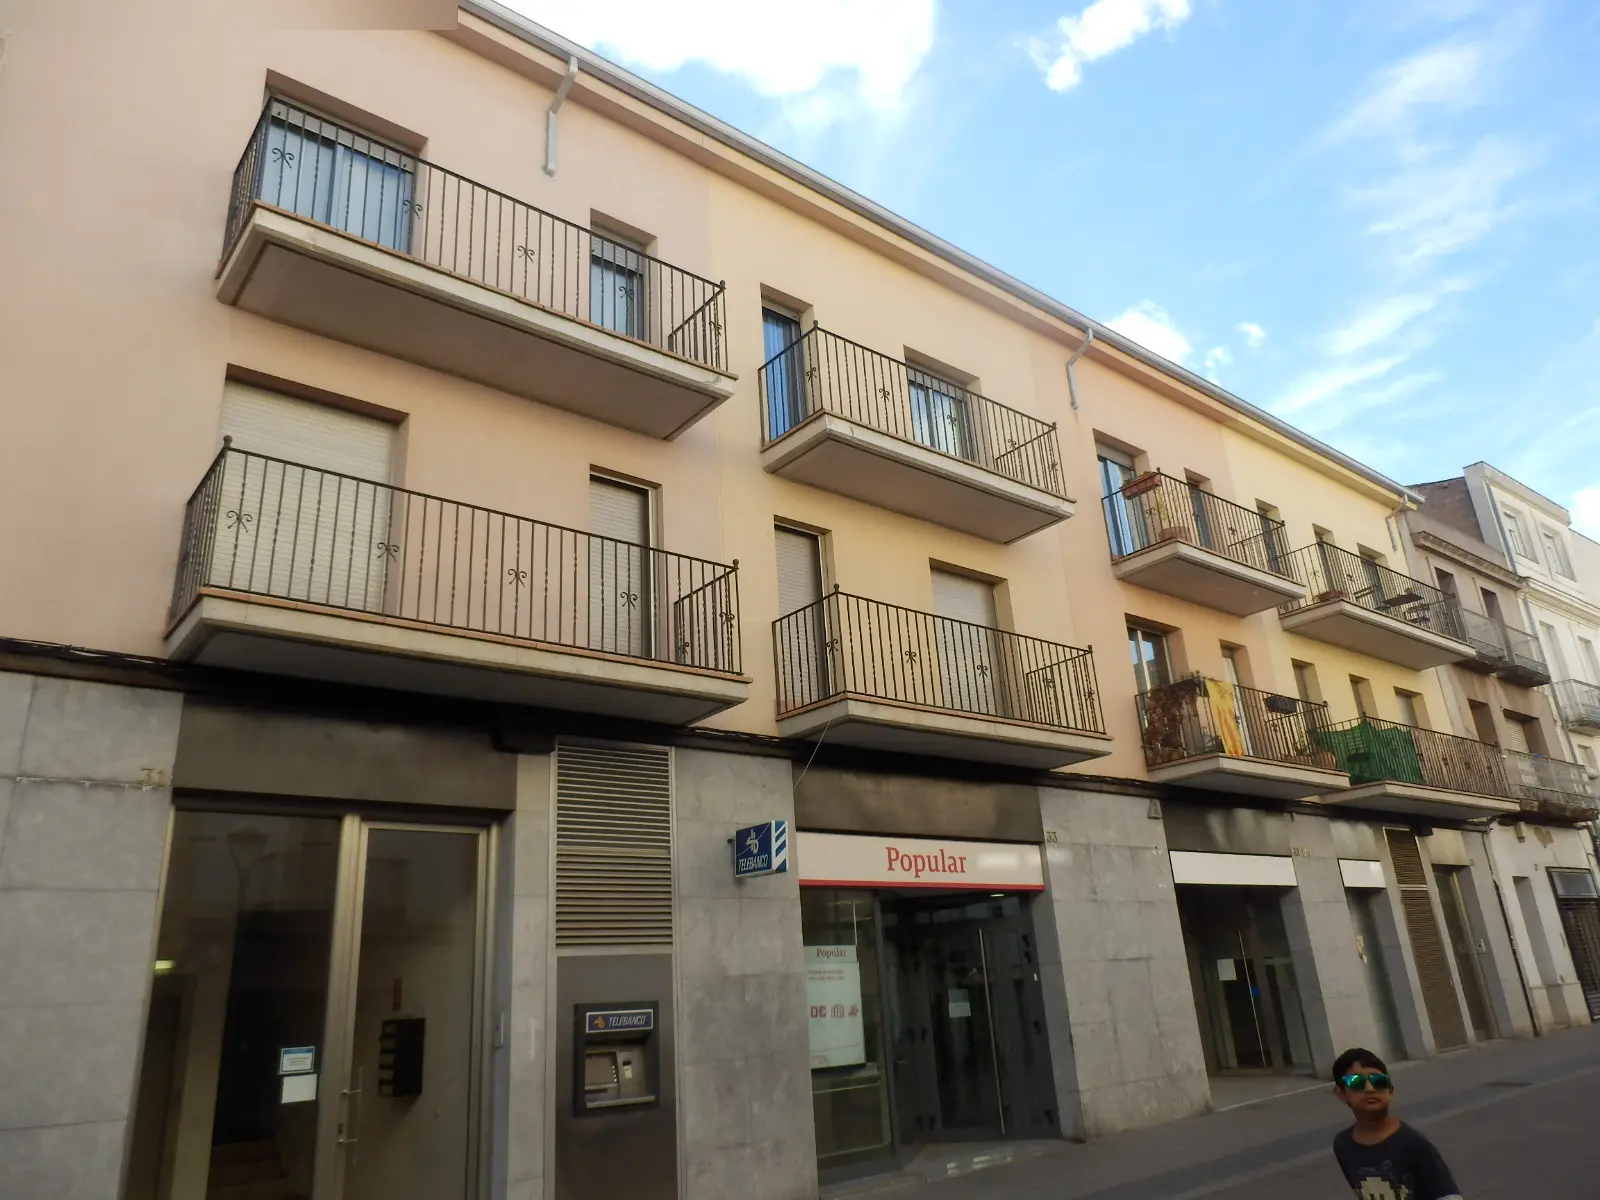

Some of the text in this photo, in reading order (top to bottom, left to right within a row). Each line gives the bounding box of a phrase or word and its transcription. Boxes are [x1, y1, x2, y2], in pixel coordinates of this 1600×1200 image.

[139, 767, 166, 788] 31
[1046, 831, 1058, 843] 33
[738, 854, 769, 872] TELEBANCO
[885, 846, 967, 879] Popular
[816, 947, 846, 960] Popular
[608, 1015, 646, 1028] TELEBANCO
